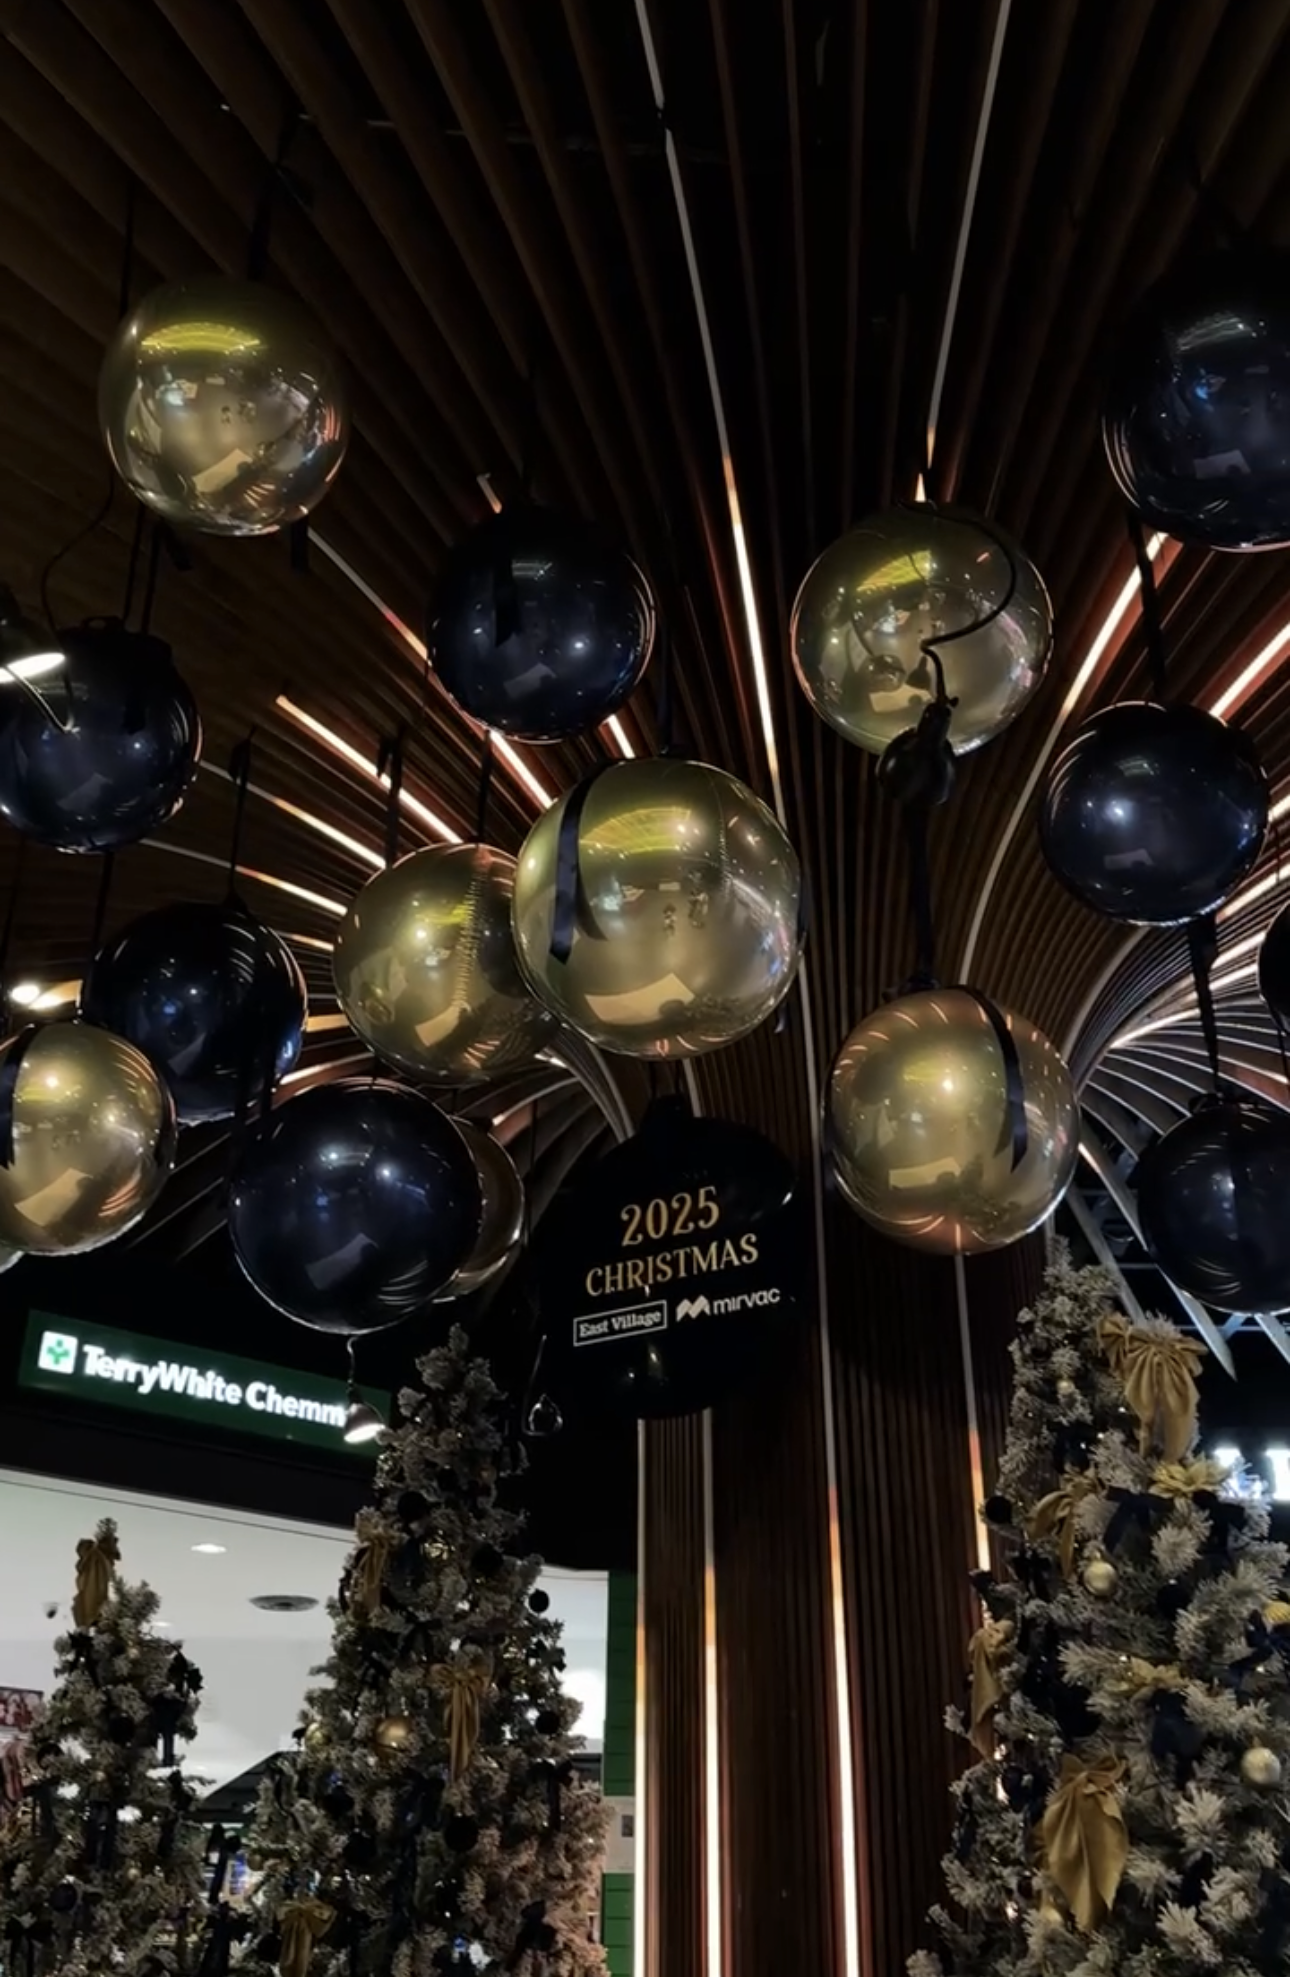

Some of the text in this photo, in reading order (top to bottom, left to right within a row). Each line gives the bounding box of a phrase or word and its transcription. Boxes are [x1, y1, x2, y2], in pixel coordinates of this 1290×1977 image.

[620, 1186, 720, 1247] 2025
[585, 1233, 759, 1297] CHRISTMAS
[579, 1310, 662, 1338] East Village
[713, 1287, 781, 1316] mirvac
[83, 1344, 349, 1428] TerryWhite Chemm
